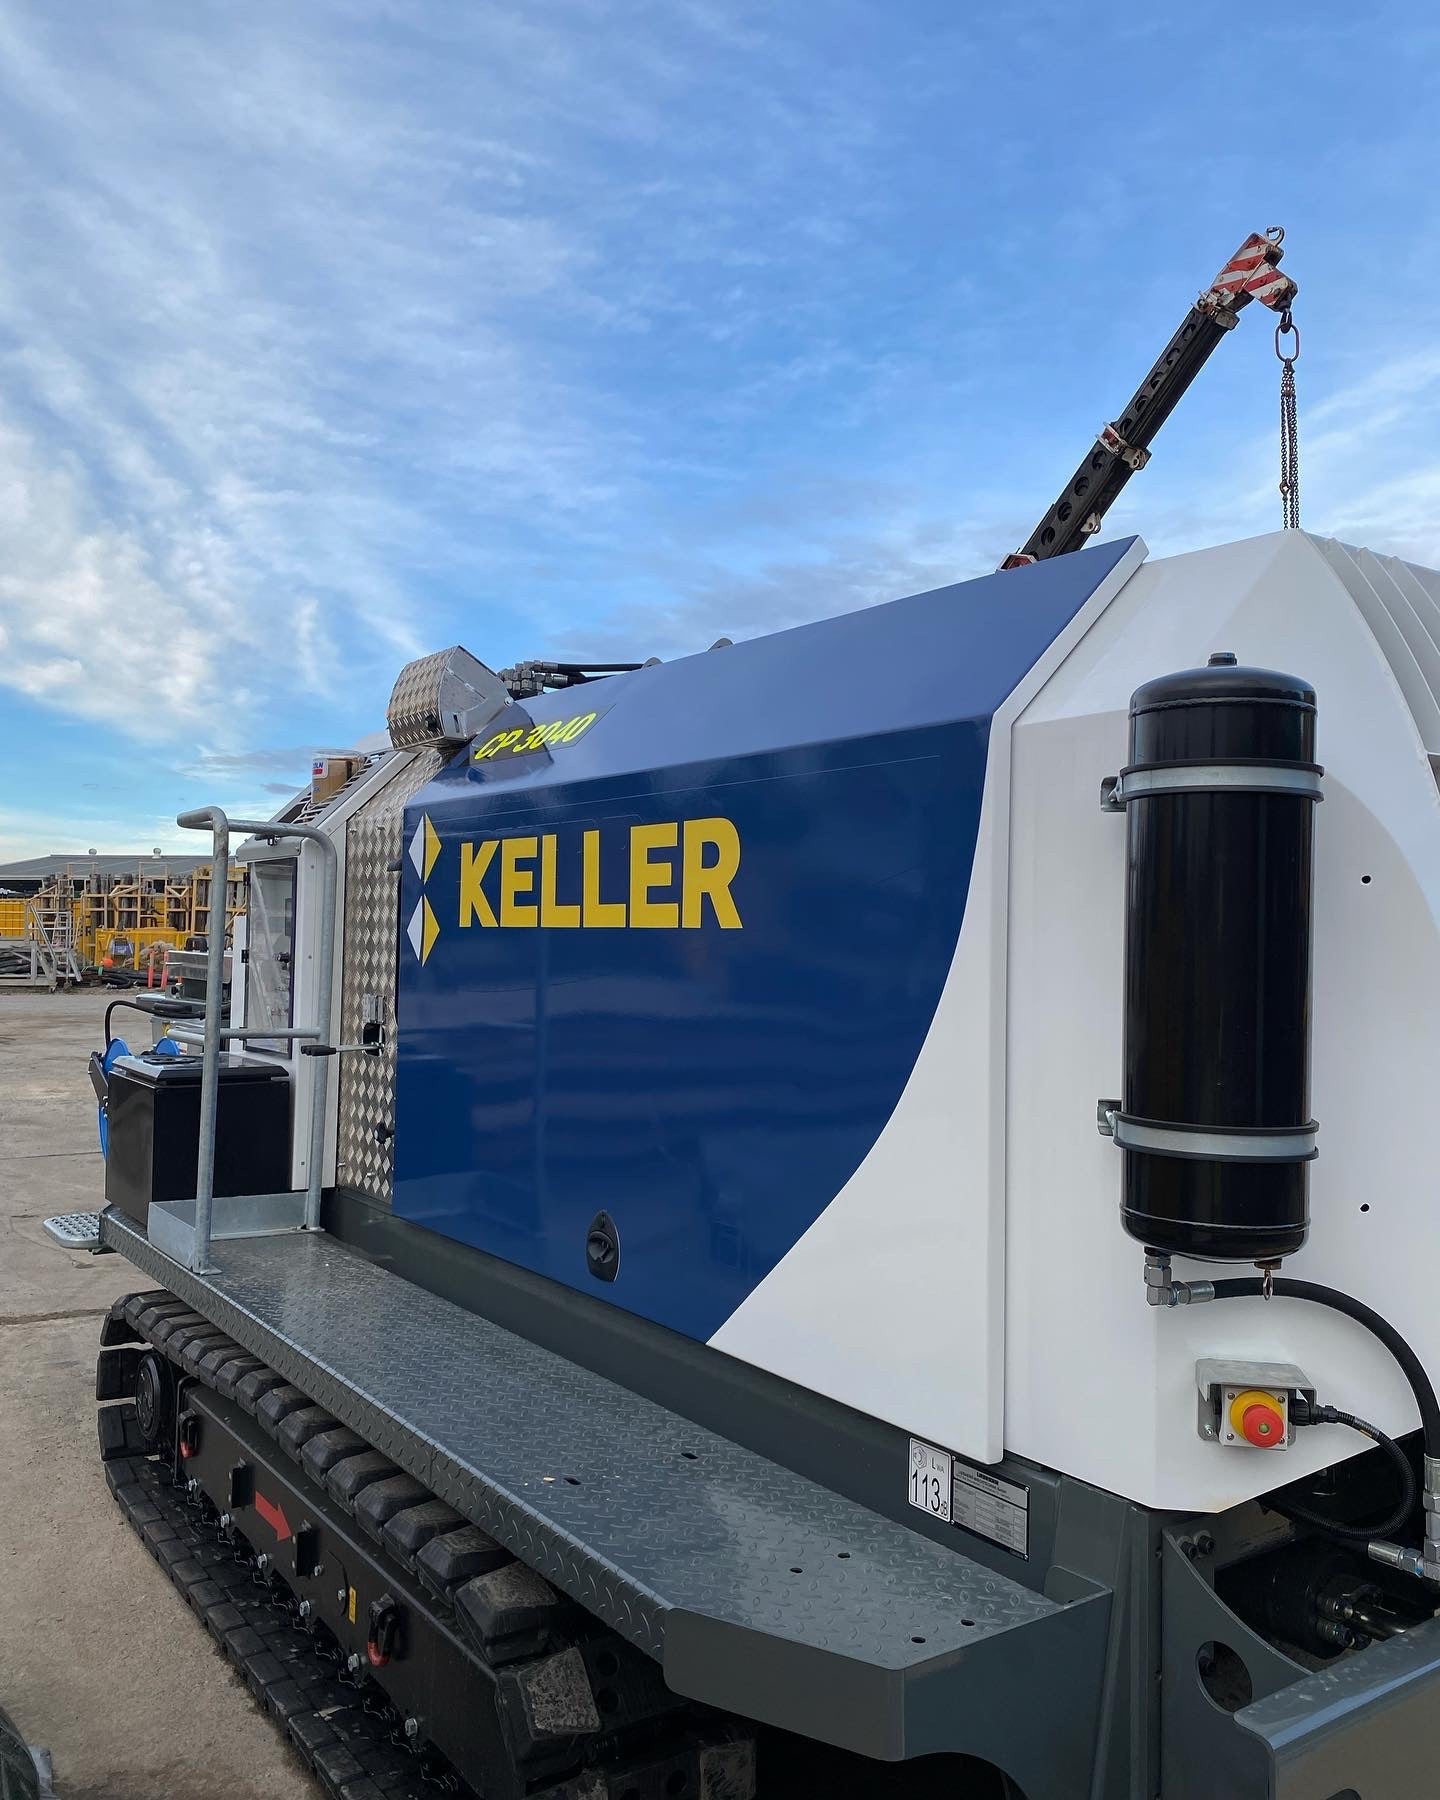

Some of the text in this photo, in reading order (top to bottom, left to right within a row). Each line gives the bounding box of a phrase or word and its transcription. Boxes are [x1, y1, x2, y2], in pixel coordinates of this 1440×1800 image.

[474, 712, 597, 760] CP 3040
[458, 816, 744, 930] KELLER
[912, 1469, 940, 1512] 113
